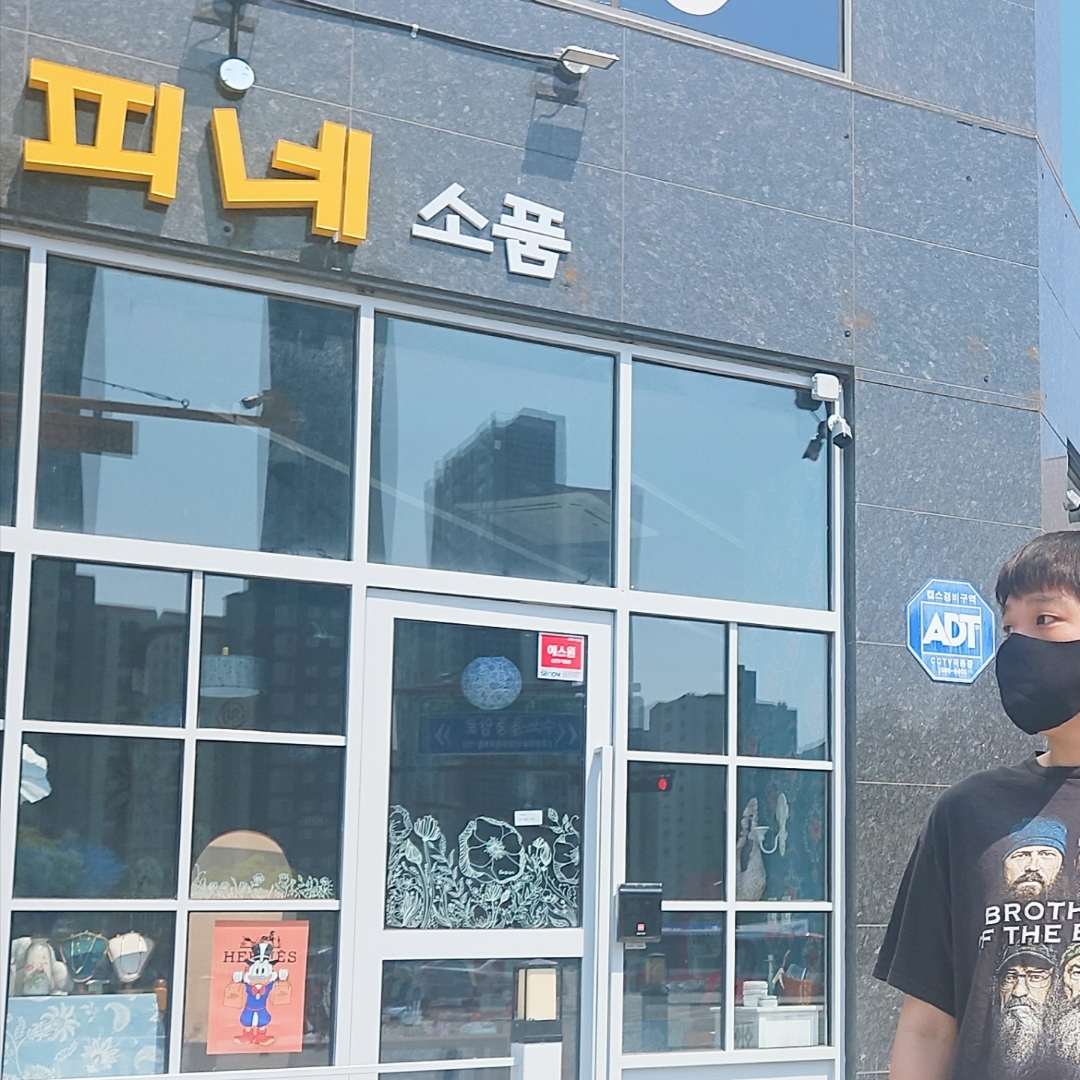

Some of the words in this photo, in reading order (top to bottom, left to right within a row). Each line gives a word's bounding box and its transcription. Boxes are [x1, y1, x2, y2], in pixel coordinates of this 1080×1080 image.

[23, 57, 373, 246] 피네
[411, 181, 572, 279] 소품
[926, 589, 977, 605] 캡스경비구역
[923, 611, 981, 649] ADT
[978, 928, 996, 949] F
[1002, 923, 1063, 945] THE
